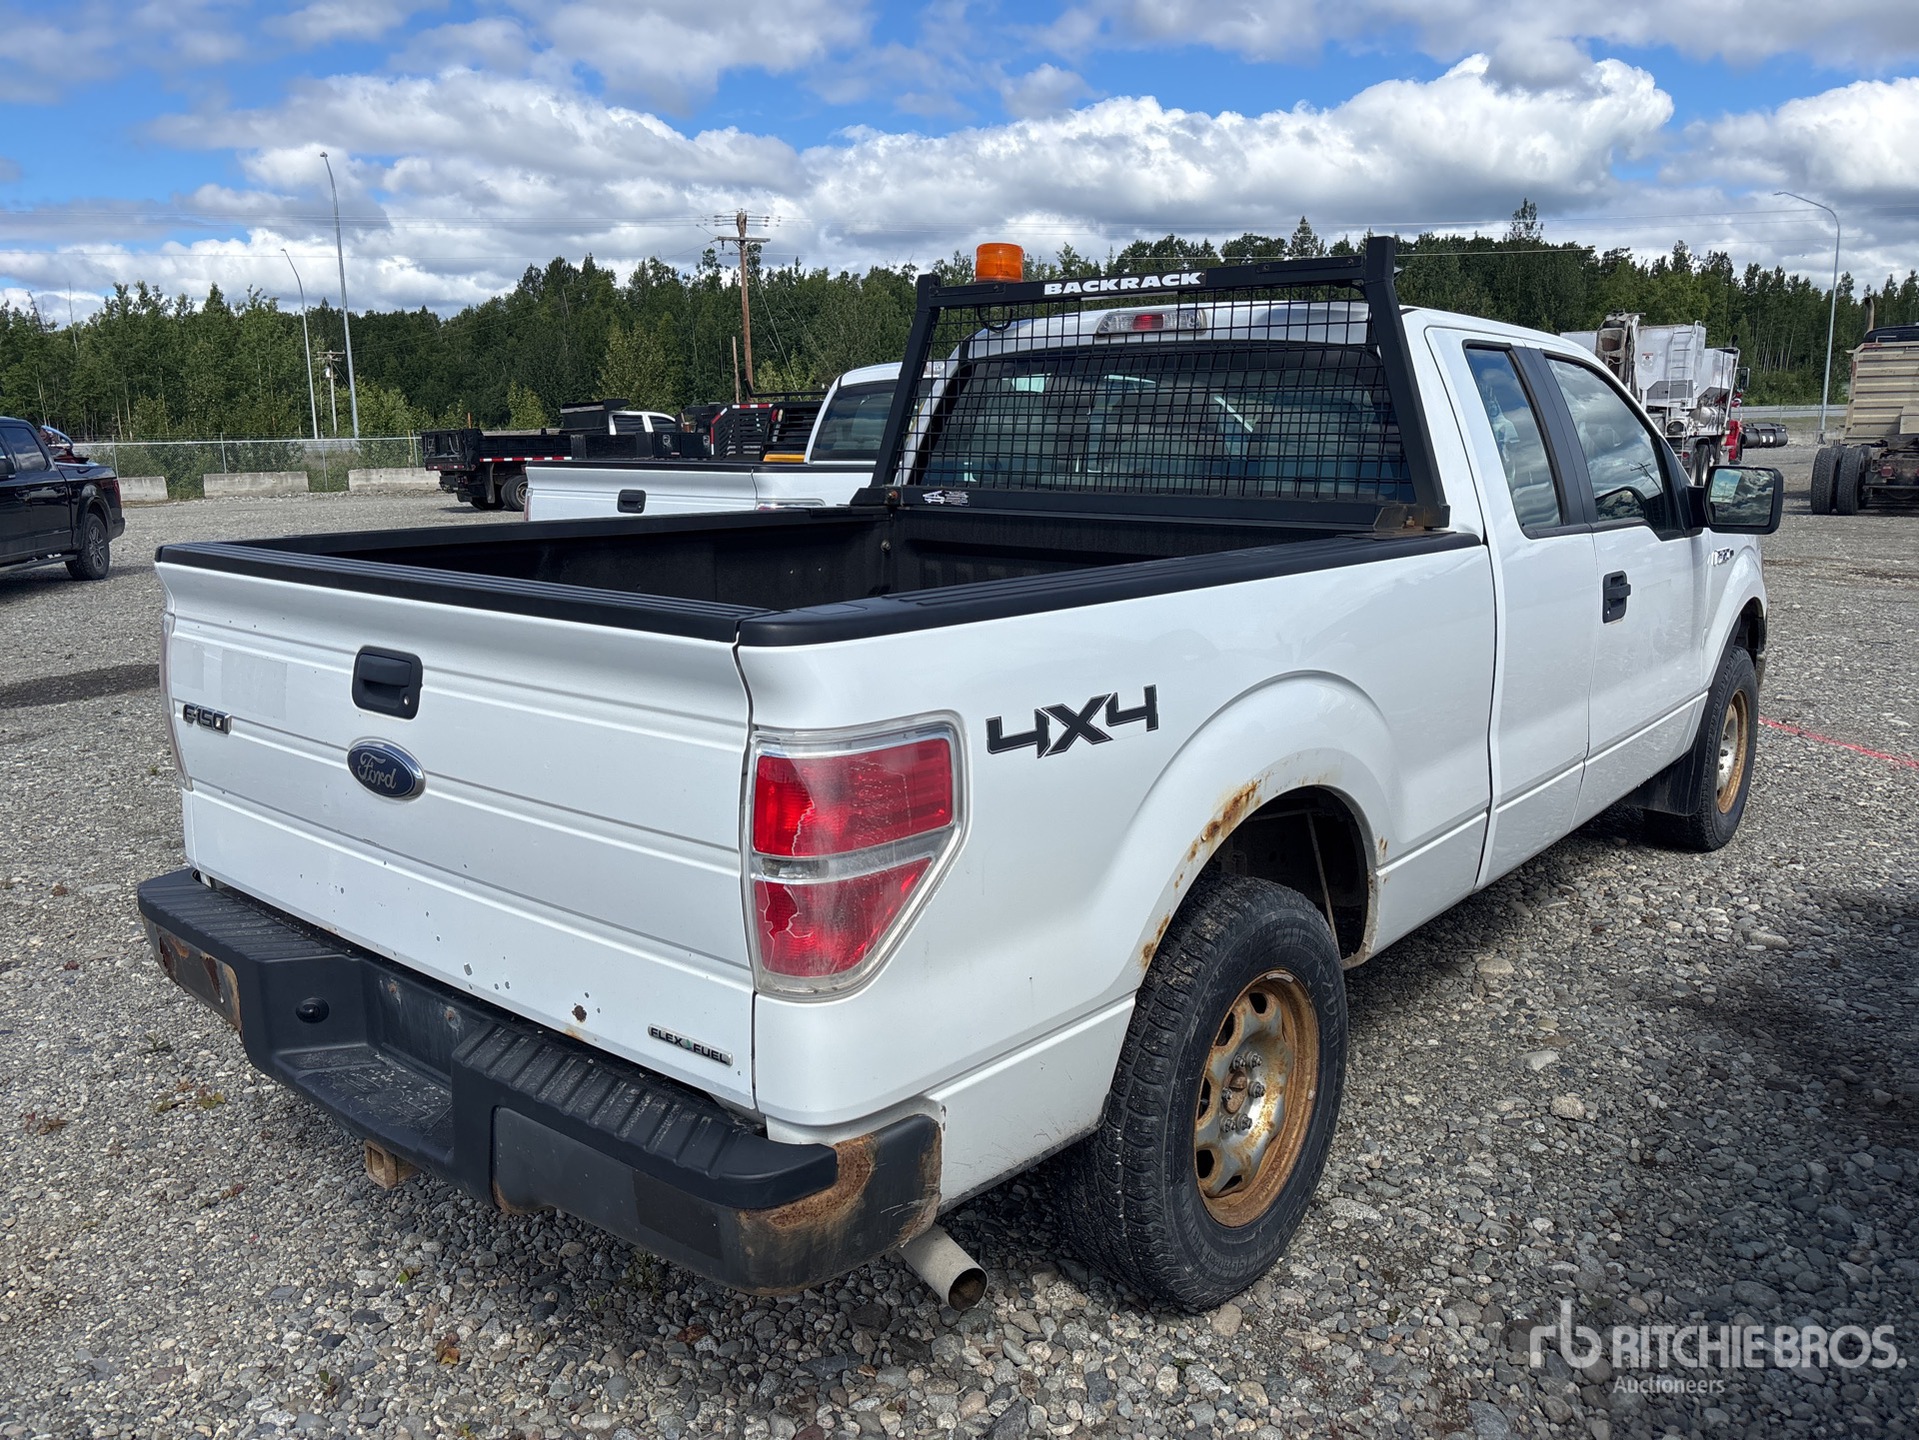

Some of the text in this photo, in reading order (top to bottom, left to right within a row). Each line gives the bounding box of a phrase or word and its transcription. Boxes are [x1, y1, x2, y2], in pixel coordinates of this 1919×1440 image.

[1044, 272, 1202, 296] BACKRACK
[357, 751, 398, 791] Ford
[650, 1027, 728, 1065] FLEX FUEL
